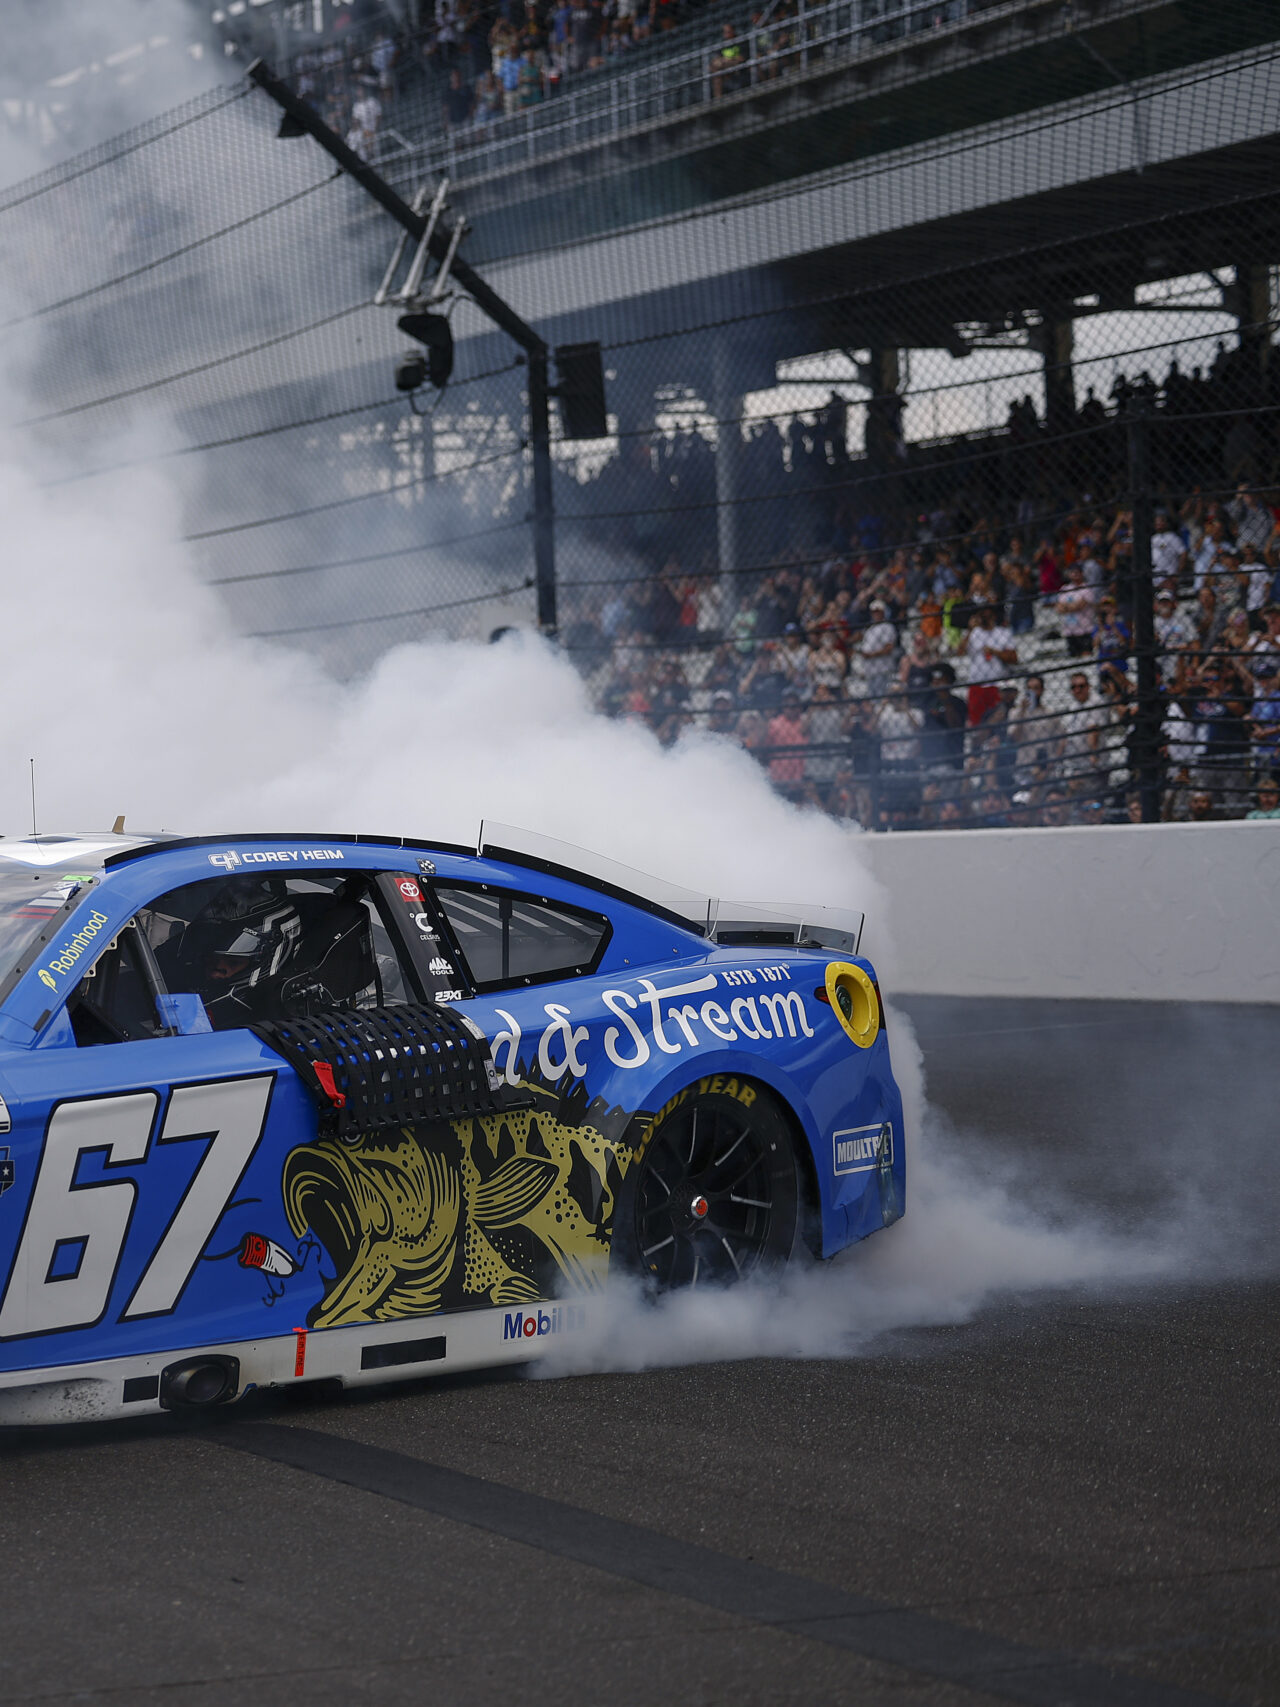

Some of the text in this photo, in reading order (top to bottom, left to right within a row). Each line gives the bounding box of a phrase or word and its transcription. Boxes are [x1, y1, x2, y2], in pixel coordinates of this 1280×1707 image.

[242, 850, 344, 863] COREY HEIM
[49, 910, 109, 976] Robinhood
[428, 957, 453, 971] MAC
[721, 969, 757, 986] ESTB
[538, 1003, 590, 1081] &
[602, 973, 814, 1069] Stream
[837, 1134, 889, 1164] MOULTRE
[503, 1307, 563, 1340] Mobil
